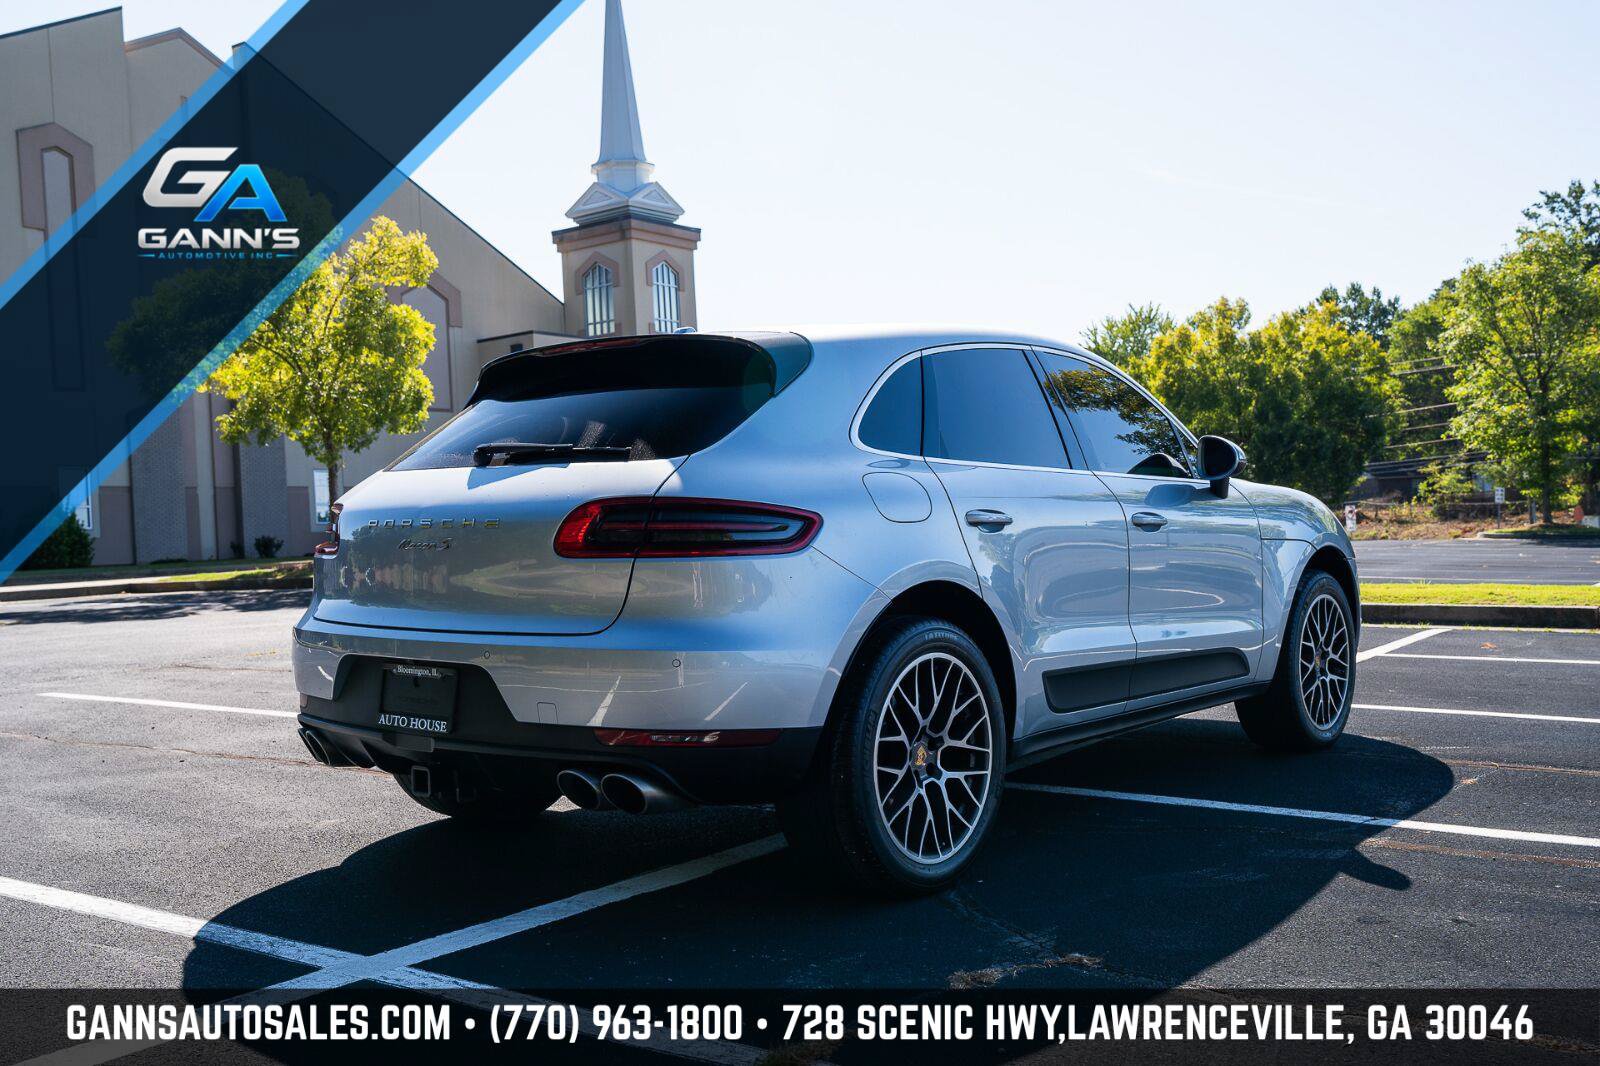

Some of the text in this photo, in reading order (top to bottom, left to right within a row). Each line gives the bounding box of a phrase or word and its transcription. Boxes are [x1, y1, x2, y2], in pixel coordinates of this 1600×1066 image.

[368, 518, 499, 529] PORSCHE
[398, 538, 453, 550] Macan S
[379, 713, 447, 732] AUTO HOUSE
